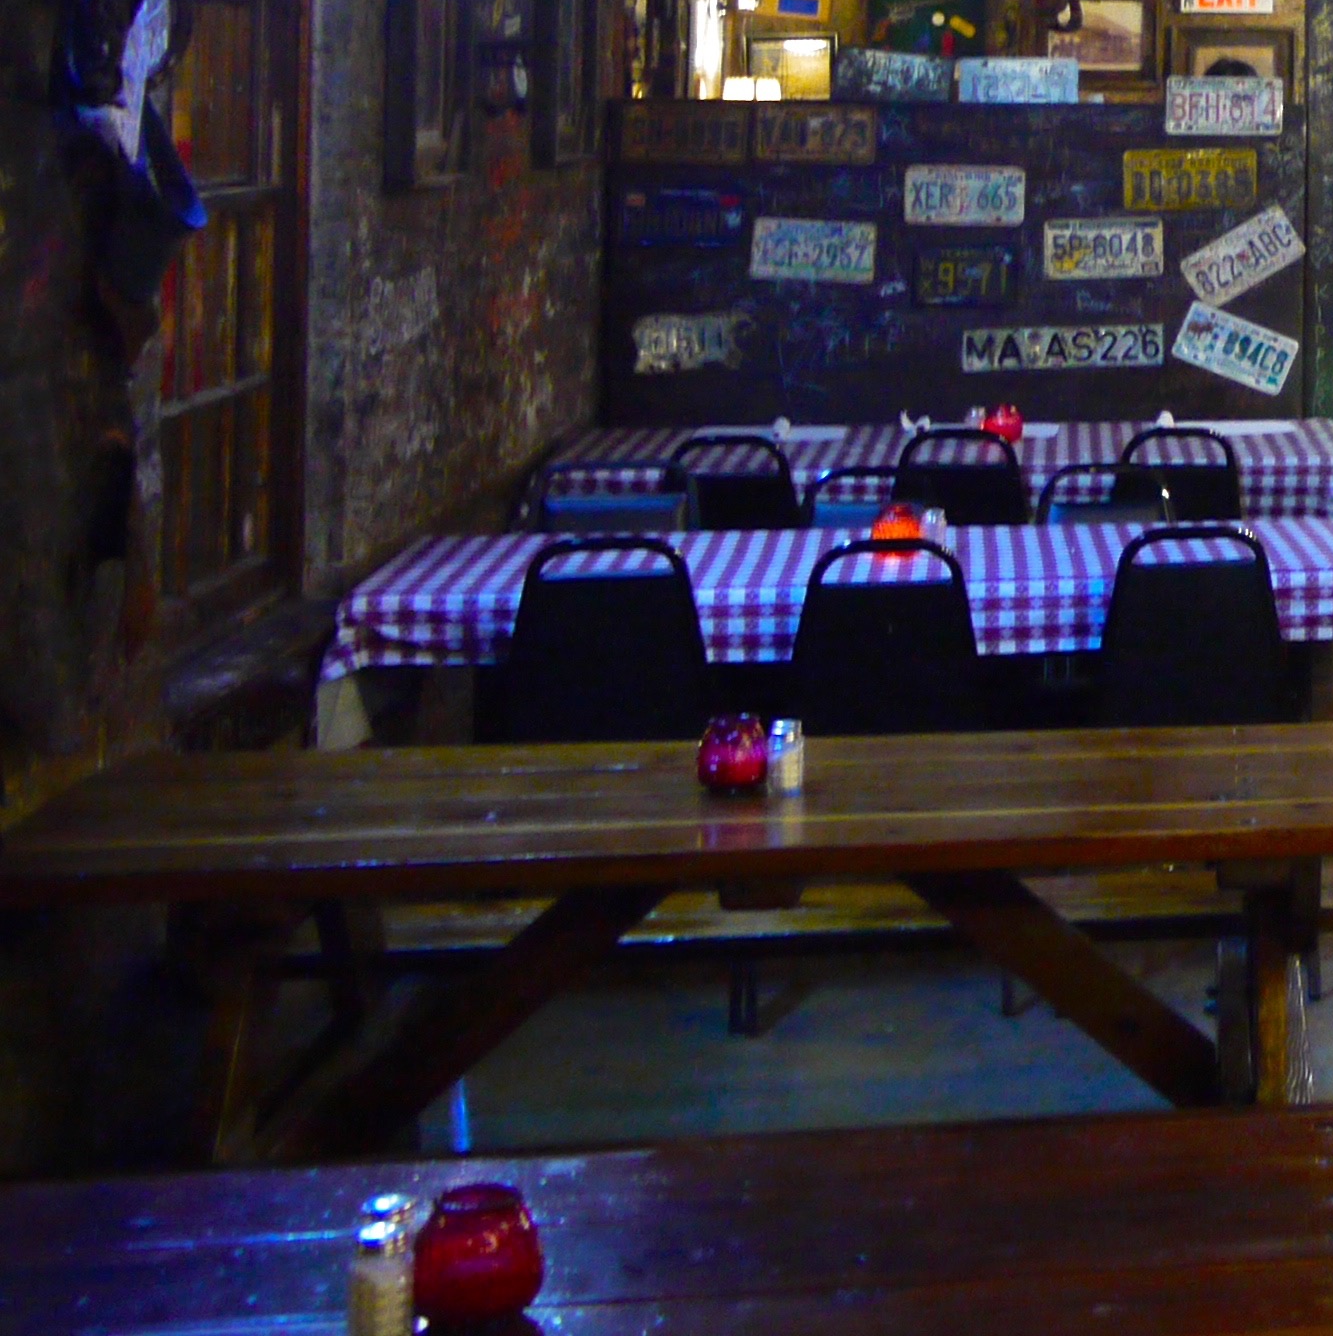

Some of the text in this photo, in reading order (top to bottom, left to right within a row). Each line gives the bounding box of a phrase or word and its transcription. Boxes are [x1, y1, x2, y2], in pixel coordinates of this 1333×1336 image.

[911, 180, 1018, 211] XER 665
[965, 333, 1025, 364] MA
